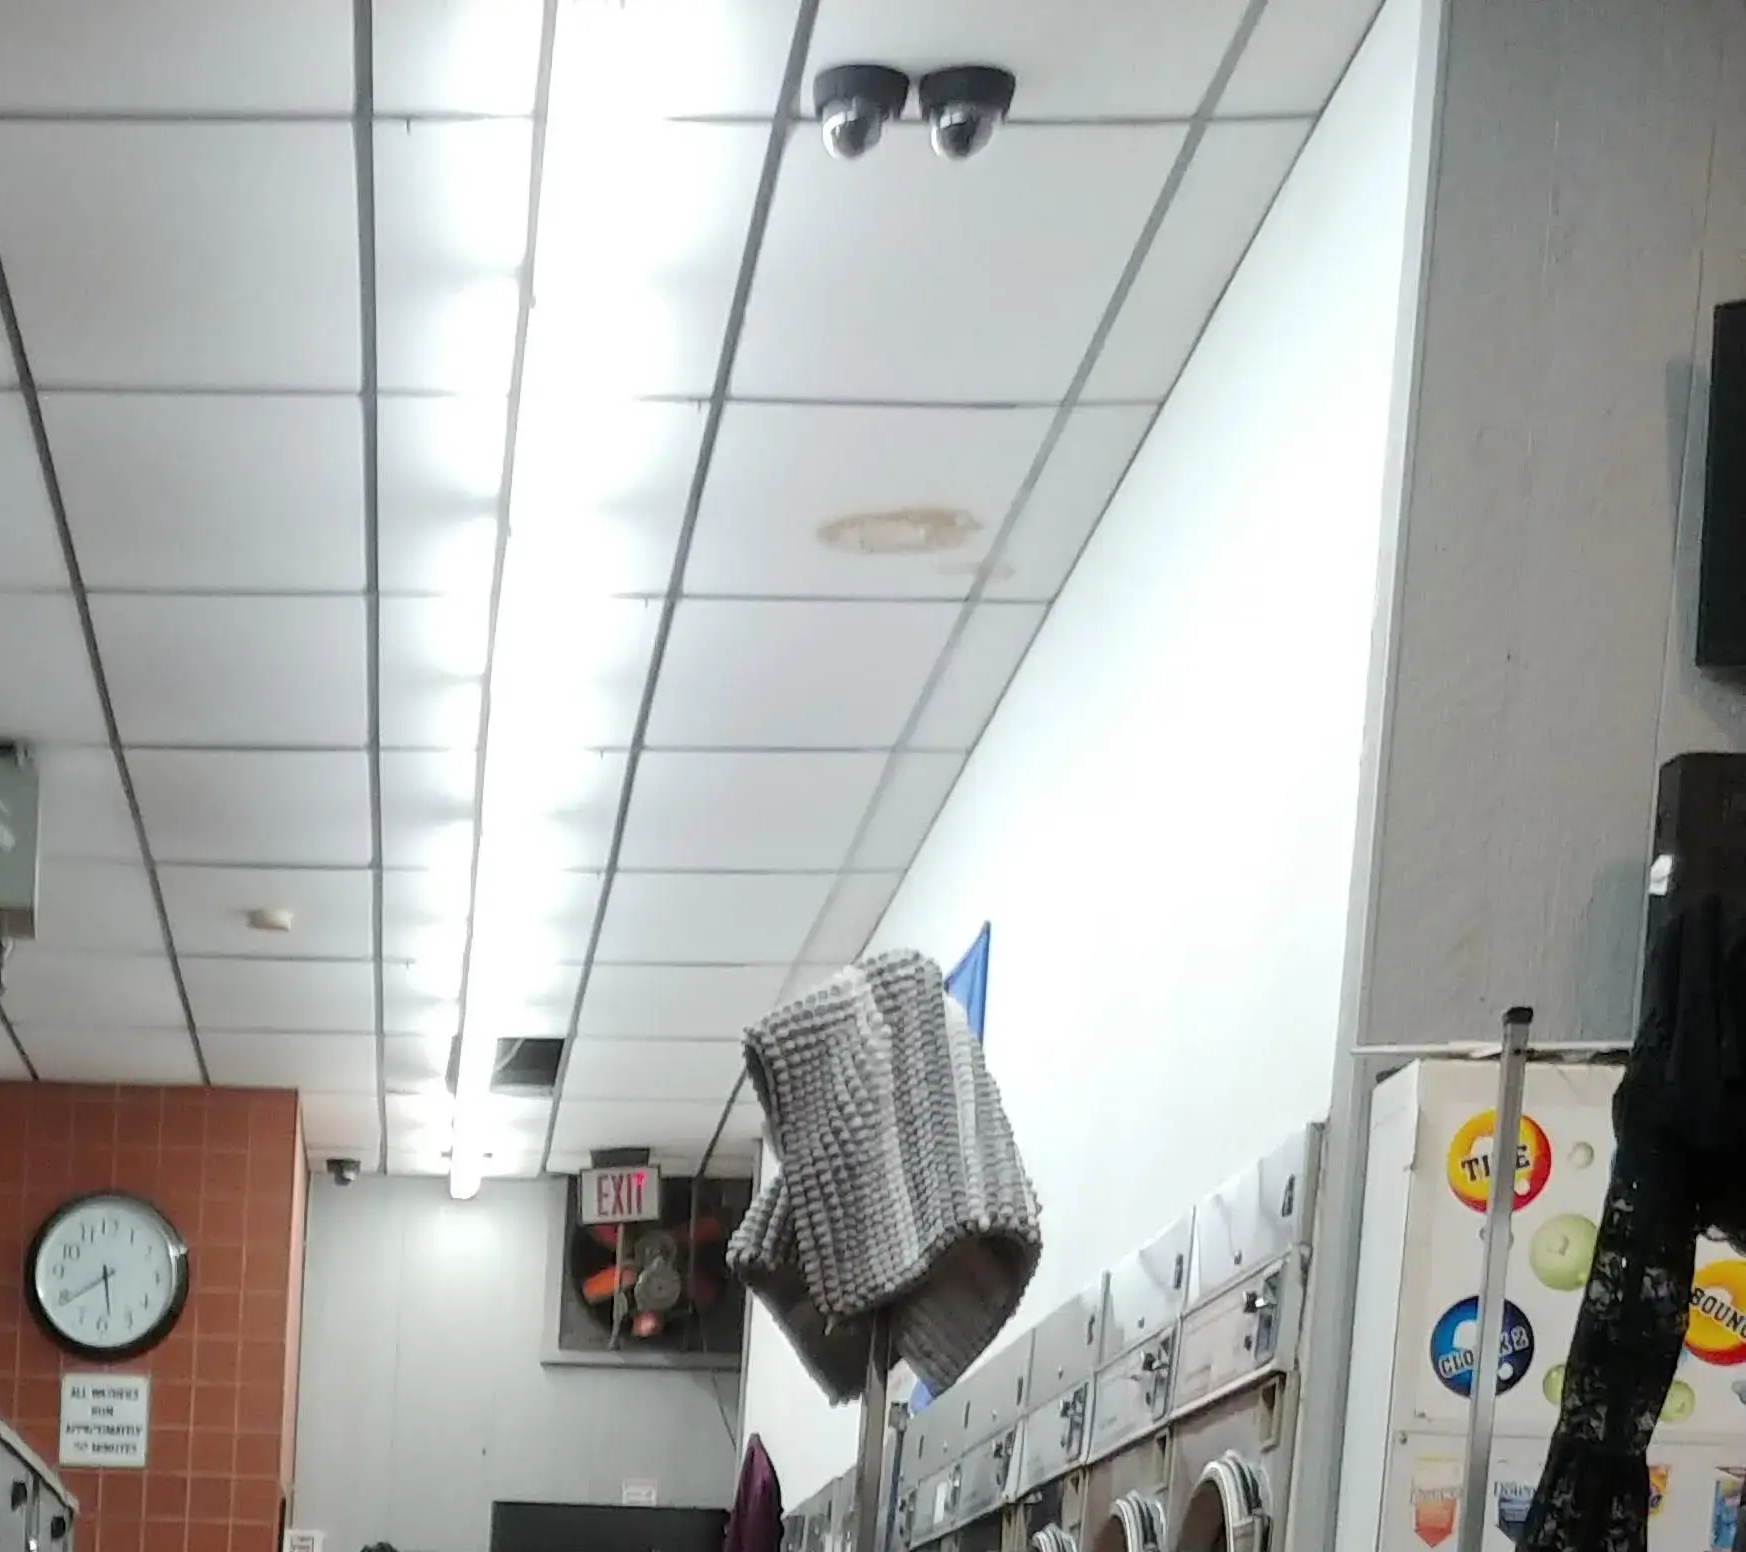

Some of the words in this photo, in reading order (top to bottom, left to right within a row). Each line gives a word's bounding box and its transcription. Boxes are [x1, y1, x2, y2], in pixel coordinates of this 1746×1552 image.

[1461, 1144, 1531, 1182] TIE
[597, 1171, 645, 1217] EXIT
[62, 1242, 81, 1261] 10
[1438, 1329, 1513, 1378] CLOX
